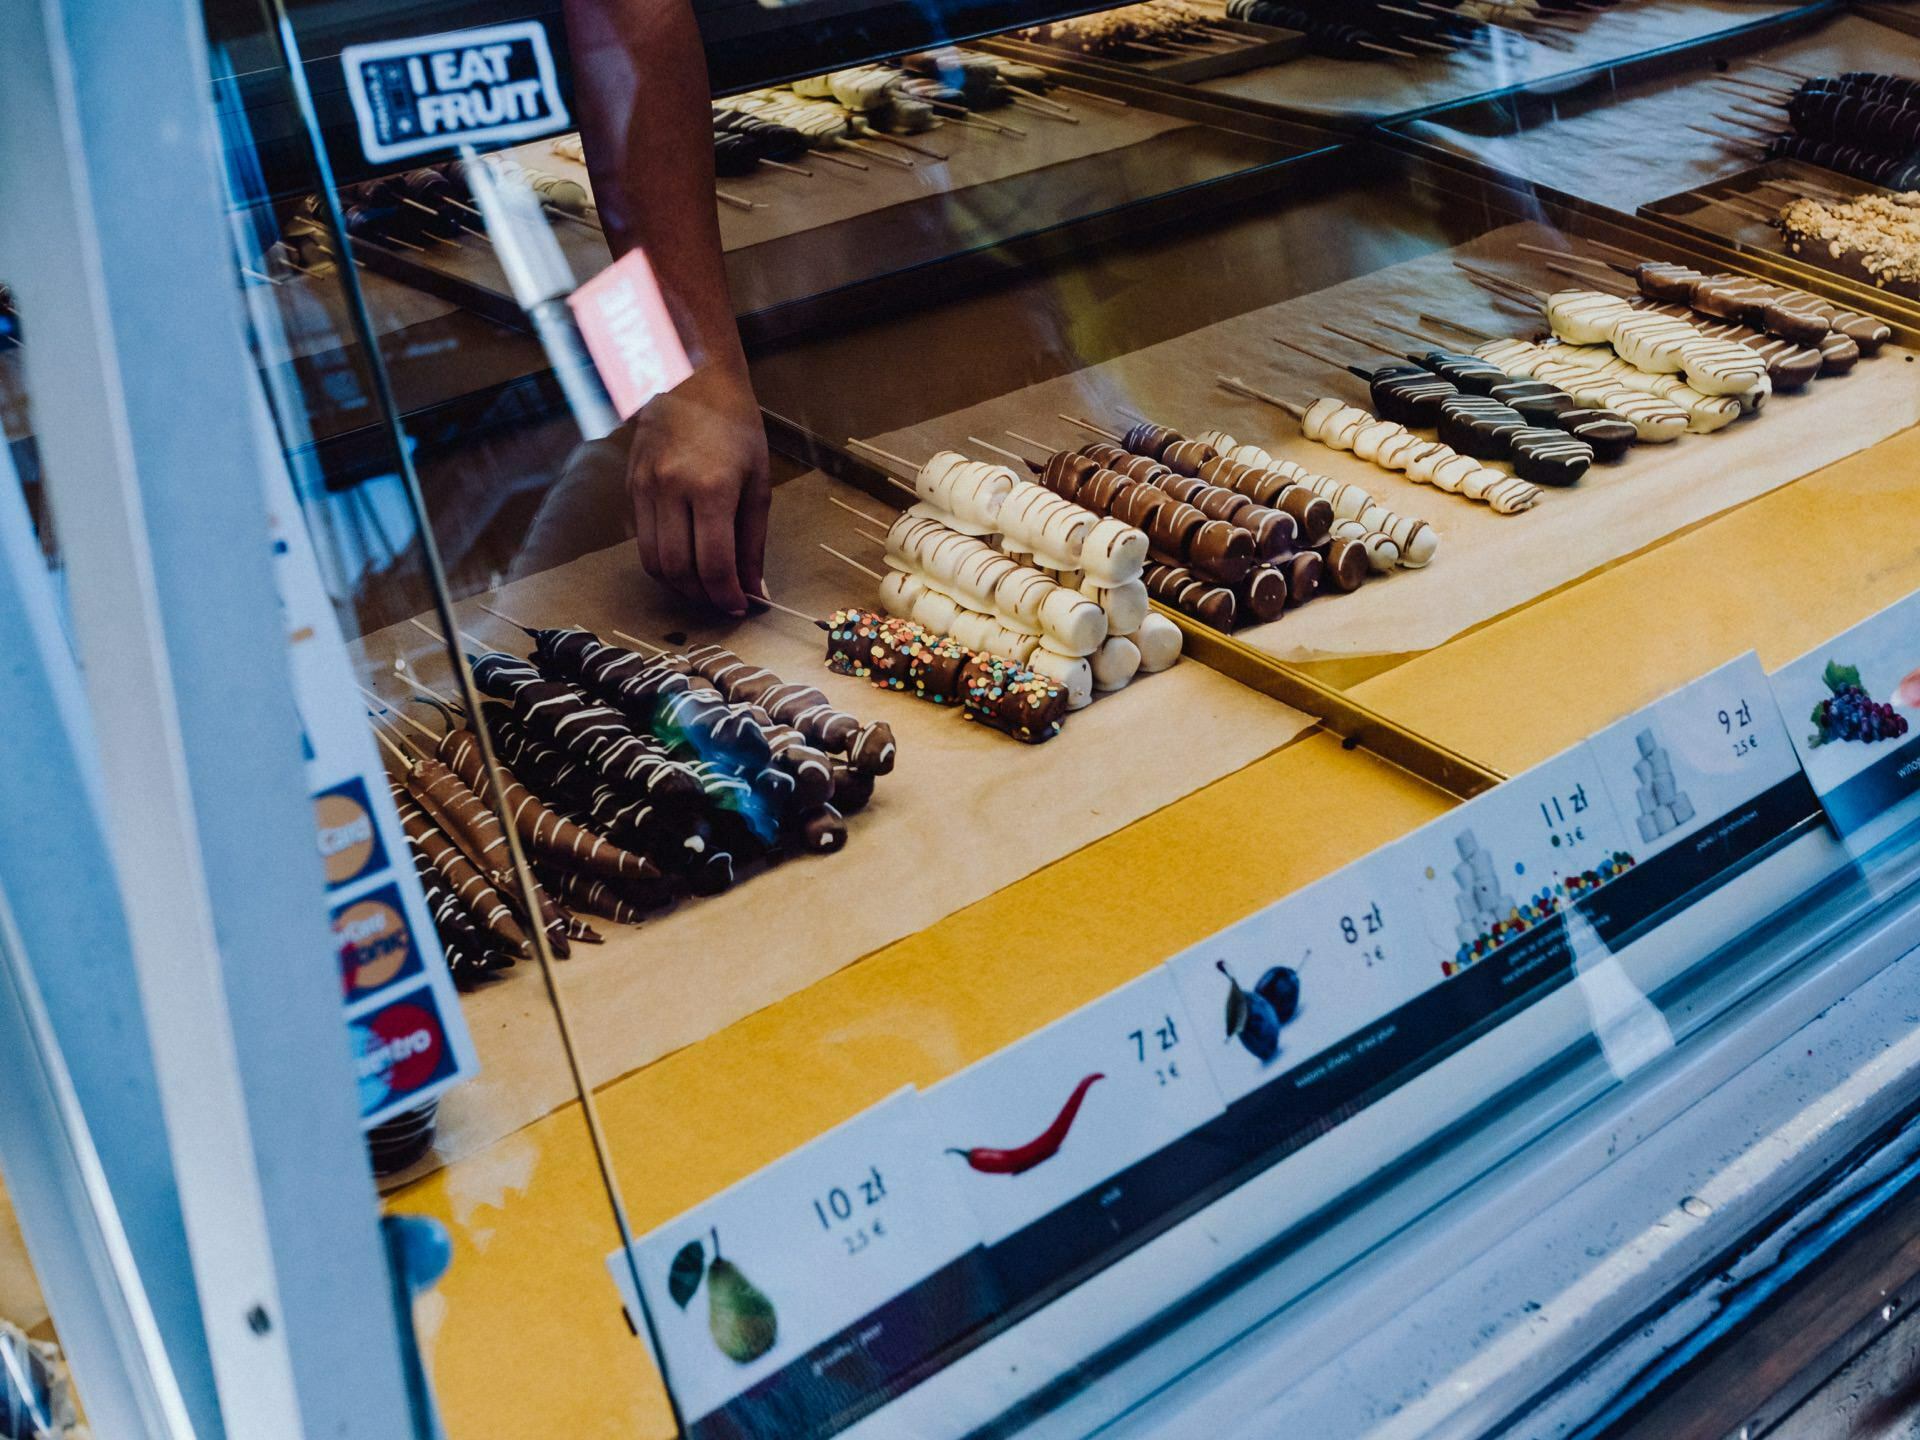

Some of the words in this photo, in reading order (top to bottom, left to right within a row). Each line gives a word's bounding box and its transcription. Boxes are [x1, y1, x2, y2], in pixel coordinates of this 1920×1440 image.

[407, 57, 428, 95] I
[430, 44, 512, 91] EAT
[417, 79, 540, 134] FRUIT
[1717, 710, 1731, 735] 9
[1735, 698, 1752, 728] zł
[1540, 795, 1564, 828] 11
[1568, 782, 1588, 814] zł
[1340, 915, 1358, 944] 8
[1362, 901, 1383, 934] zł
[1128, 1029, 1144, 1062] 7
[1155, 1014, 1179, 1051] zł
[814, 1187, 851, 1230] 10
[858, 1166, 887, 1206] zł
